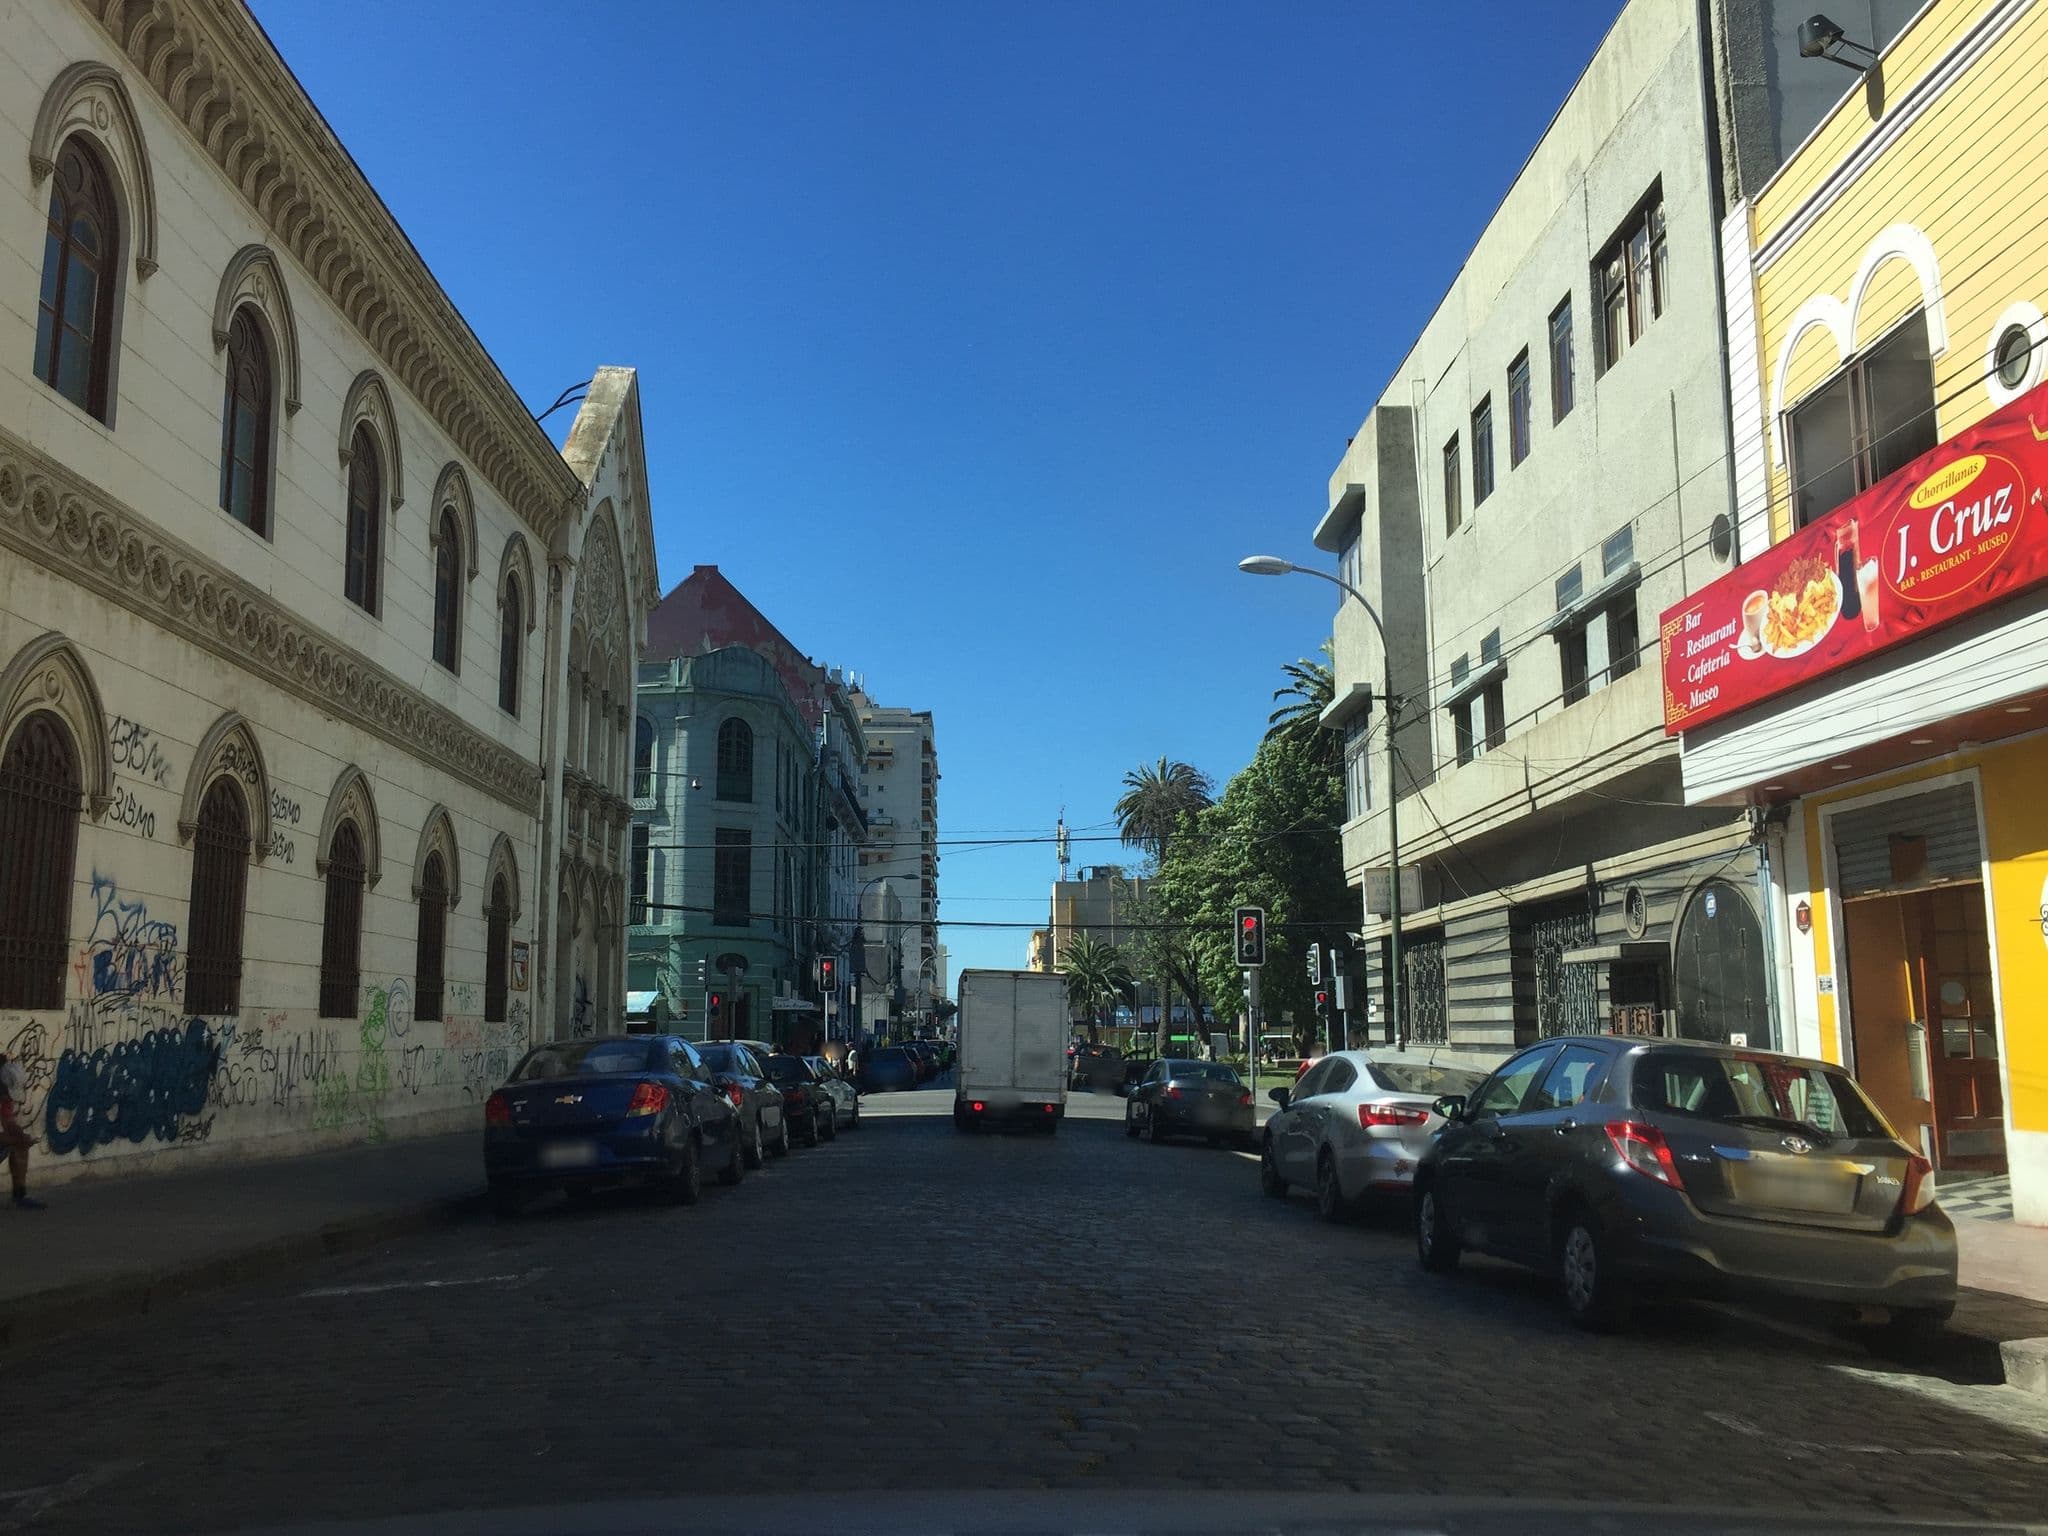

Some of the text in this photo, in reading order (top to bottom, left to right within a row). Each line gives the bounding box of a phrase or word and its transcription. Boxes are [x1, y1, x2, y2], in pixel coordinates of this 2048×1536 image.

[1916, 462, 1979, 504] Chorrillanas
[1896, 482, 2013, 584] J. Cruz
[1900, 577, 1916, 592] BAR
[1920, 548, 1972, 582] RESTAURANT
[1977, 531, 2008, 556] MUSEO
[1685, 613, 1702, 633] Bar
[1686, 618, 1737, 658] Restaurant
[1688, 648, 1731, 684] Cafetería
[1689, 685, 1719, 710] Museo
